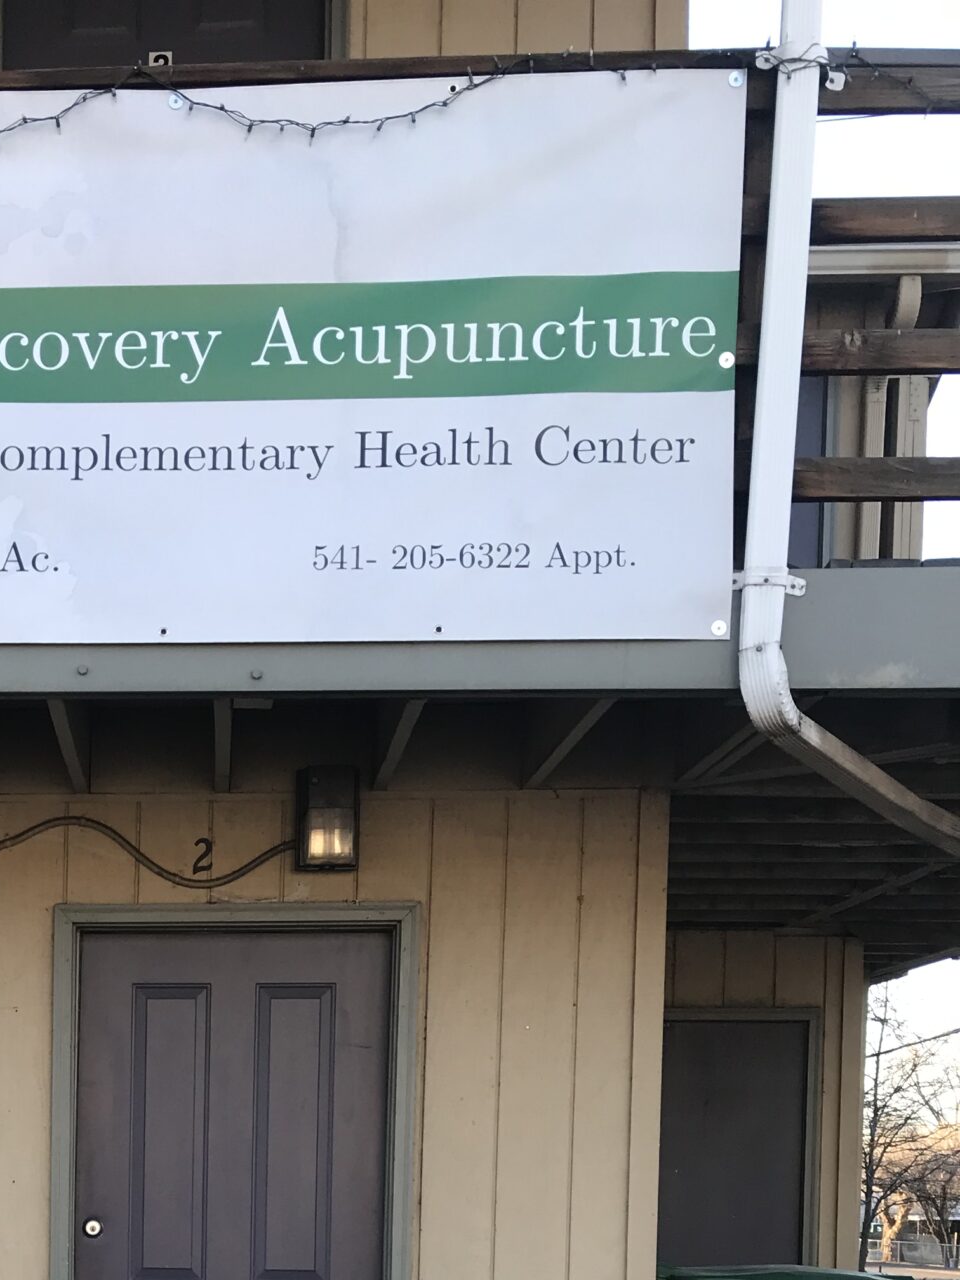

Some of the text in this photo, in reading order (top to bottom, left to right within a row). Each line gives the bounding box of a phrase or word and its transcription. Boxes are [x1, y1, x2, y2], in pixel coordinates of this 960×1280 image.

[251, 306, 717, 380] Acupuncture
[354, 426, 513, 470] Health
[534, 424, 696, 467] Center
[391, 542, 532, 570] 205-6322
[545, 540, 637, 575] Appt.
[192, 837, 214, 875] 2
